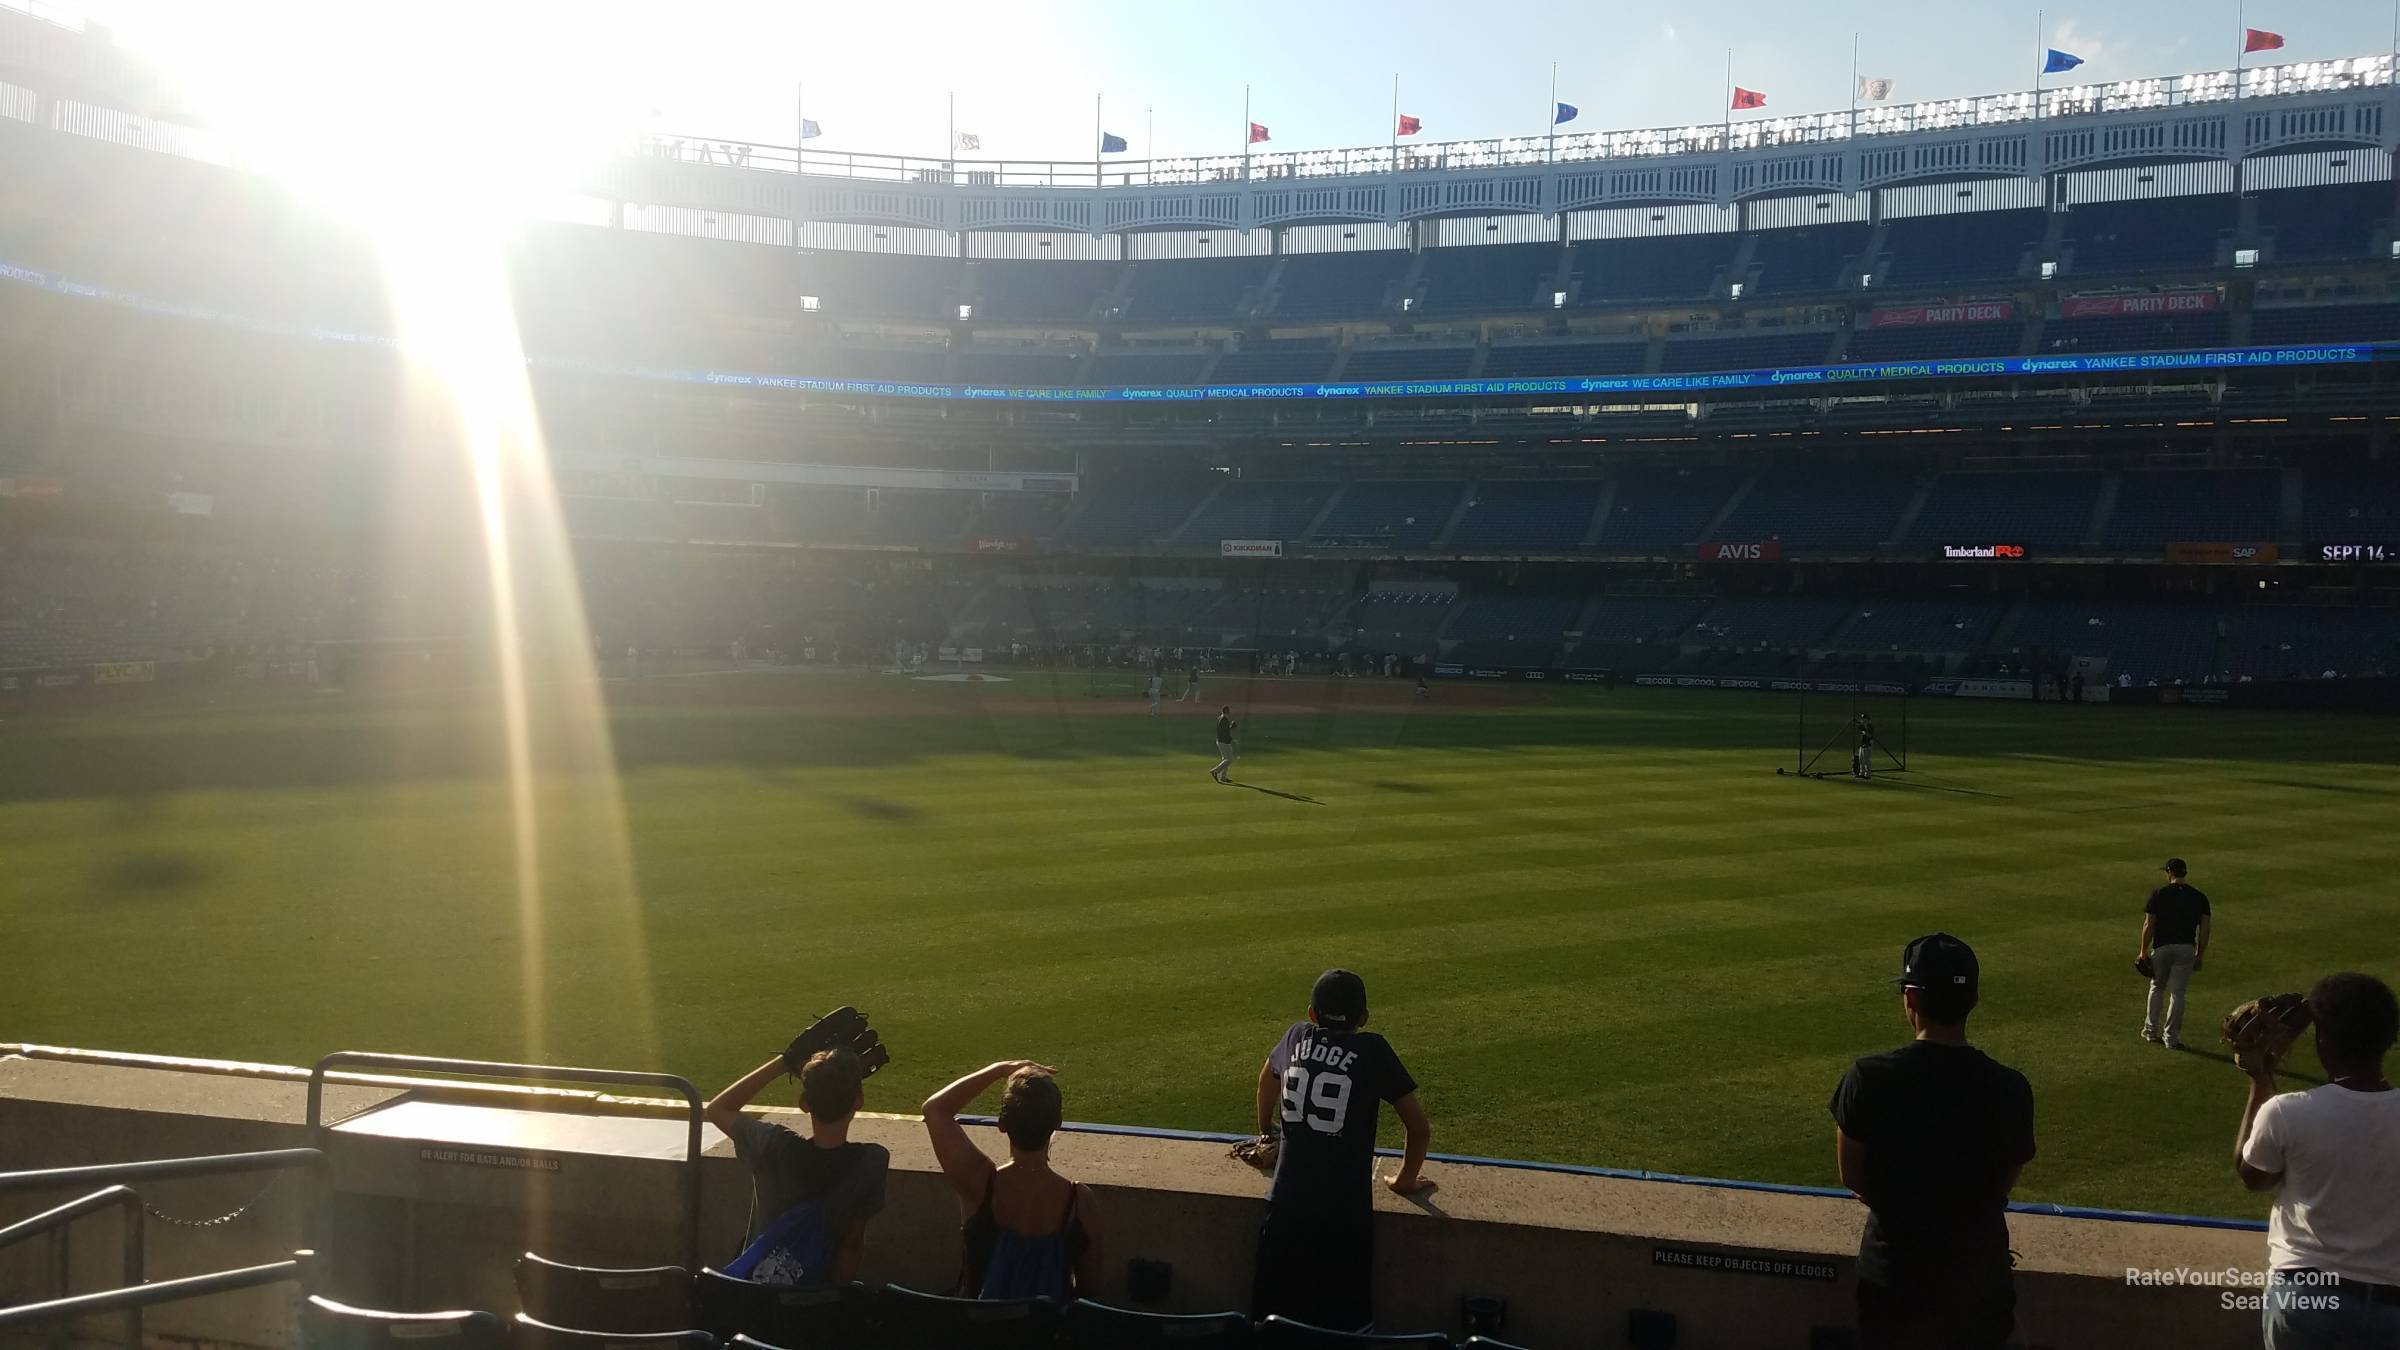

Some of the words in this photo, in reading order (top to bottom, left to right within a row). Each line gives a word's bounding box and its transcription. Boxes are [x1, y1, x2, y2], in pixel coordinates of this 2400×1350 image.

[0, 262, 46, 287] RODUCTS
[1926, 306, 1966, 321] PARTY
[1967, 304, 2001, 320] DECK
[2123, 297, 2165, 312] PARTY
[2168, 295, 2205, 311] DECK
[2022, 358, 2078, 372] dynarex
[2085, 356, 2137, 369] YANKEE
[2140, 354, 2201, 367] STADIUM
[2205, 352, 2244, 364] FIRST
[2248, 351, 2272, 362] AID
[2276, 348, 2356, 362] PRODUCTS
[1771, 369, 1822, 384] dynarex
[1826, 367, 1877, 380] QUALITY
[1880, 365, 1934, 378] MEDICAL
[1936, 362, 2005, 375] PRODUCTS
[706, 371, 752, 384] dynarex
[756, 375, 797, 388] YANKEE
[799, 379, 844, 392] STADIUM
[847, 382, 875, 393] FIRST
[878, 384, 895, 394] AID
[897, 385, 951, 397] PRODUCTS
[1316, 384, 1359, 398] dynarex
[1364, 385, 1403, 395] YANKEE
[1406, 383, 1452, 394] STADIUM
[1455, 382, 1484, 392] FIRST
[1486, 381, 1504, 392] AID
[1507, 380, 1566, 391] PRODUCTS
[1581, 378, 1629, 392] dynarex
[1632, 378, 1650, 388] WE
[1652, 377, 1682, 388] CARE
[1685, 376, 1709, 387] LIKE
[1712, 374, 1751, 386] FAMILY
[964, 386, 1006, 399] dynarex
[1008, 389, 1024, 398] WE
[1026, 389, 1051, 398] CARE
[1053, 390, 1073, 398] LIKE
[1076, 389, 1107, 399] FAMILY
[1122, 387, 1162, 399] dynarex
[1166, 388, 1205, 399] QUALITY
[1208, 388, 1250, 398] MEDICAL
[1251, 387, 1304, 398] PRODUCTS
[1718, 544, 1761, 559] AVIS
[1943, 545, 1994, 557] Timberland
[2233, 547, 2257, 558] SAP
[2322, 545, 2362, 561] SEPT
[2366, 545, 2385, 561] 14
[1291, 1038, 1359, 1072] JUDGE
[1281, 1066, 1353, 1134] 99
[421, 1149, 431, 1160] BE
[433, 1150, 458, 1162] ALERT
[460, 1152, 475, 1163] FOR
[477, 1154, 497, 1165] BATS
[499, 1156, 531, 1169] AND/OR
[533, 1159, 559, 1171] BALLS
[1655, 1250, 1694, 1265] PLEASE
[1696, 1255, 1722, 1268] KEEP
[1724, 1257, 1771, 1273] OBJECTS
[1774, 1262, 1792, 1274] OFF
[1795, 1264, 1835, 1278] LEDGES
